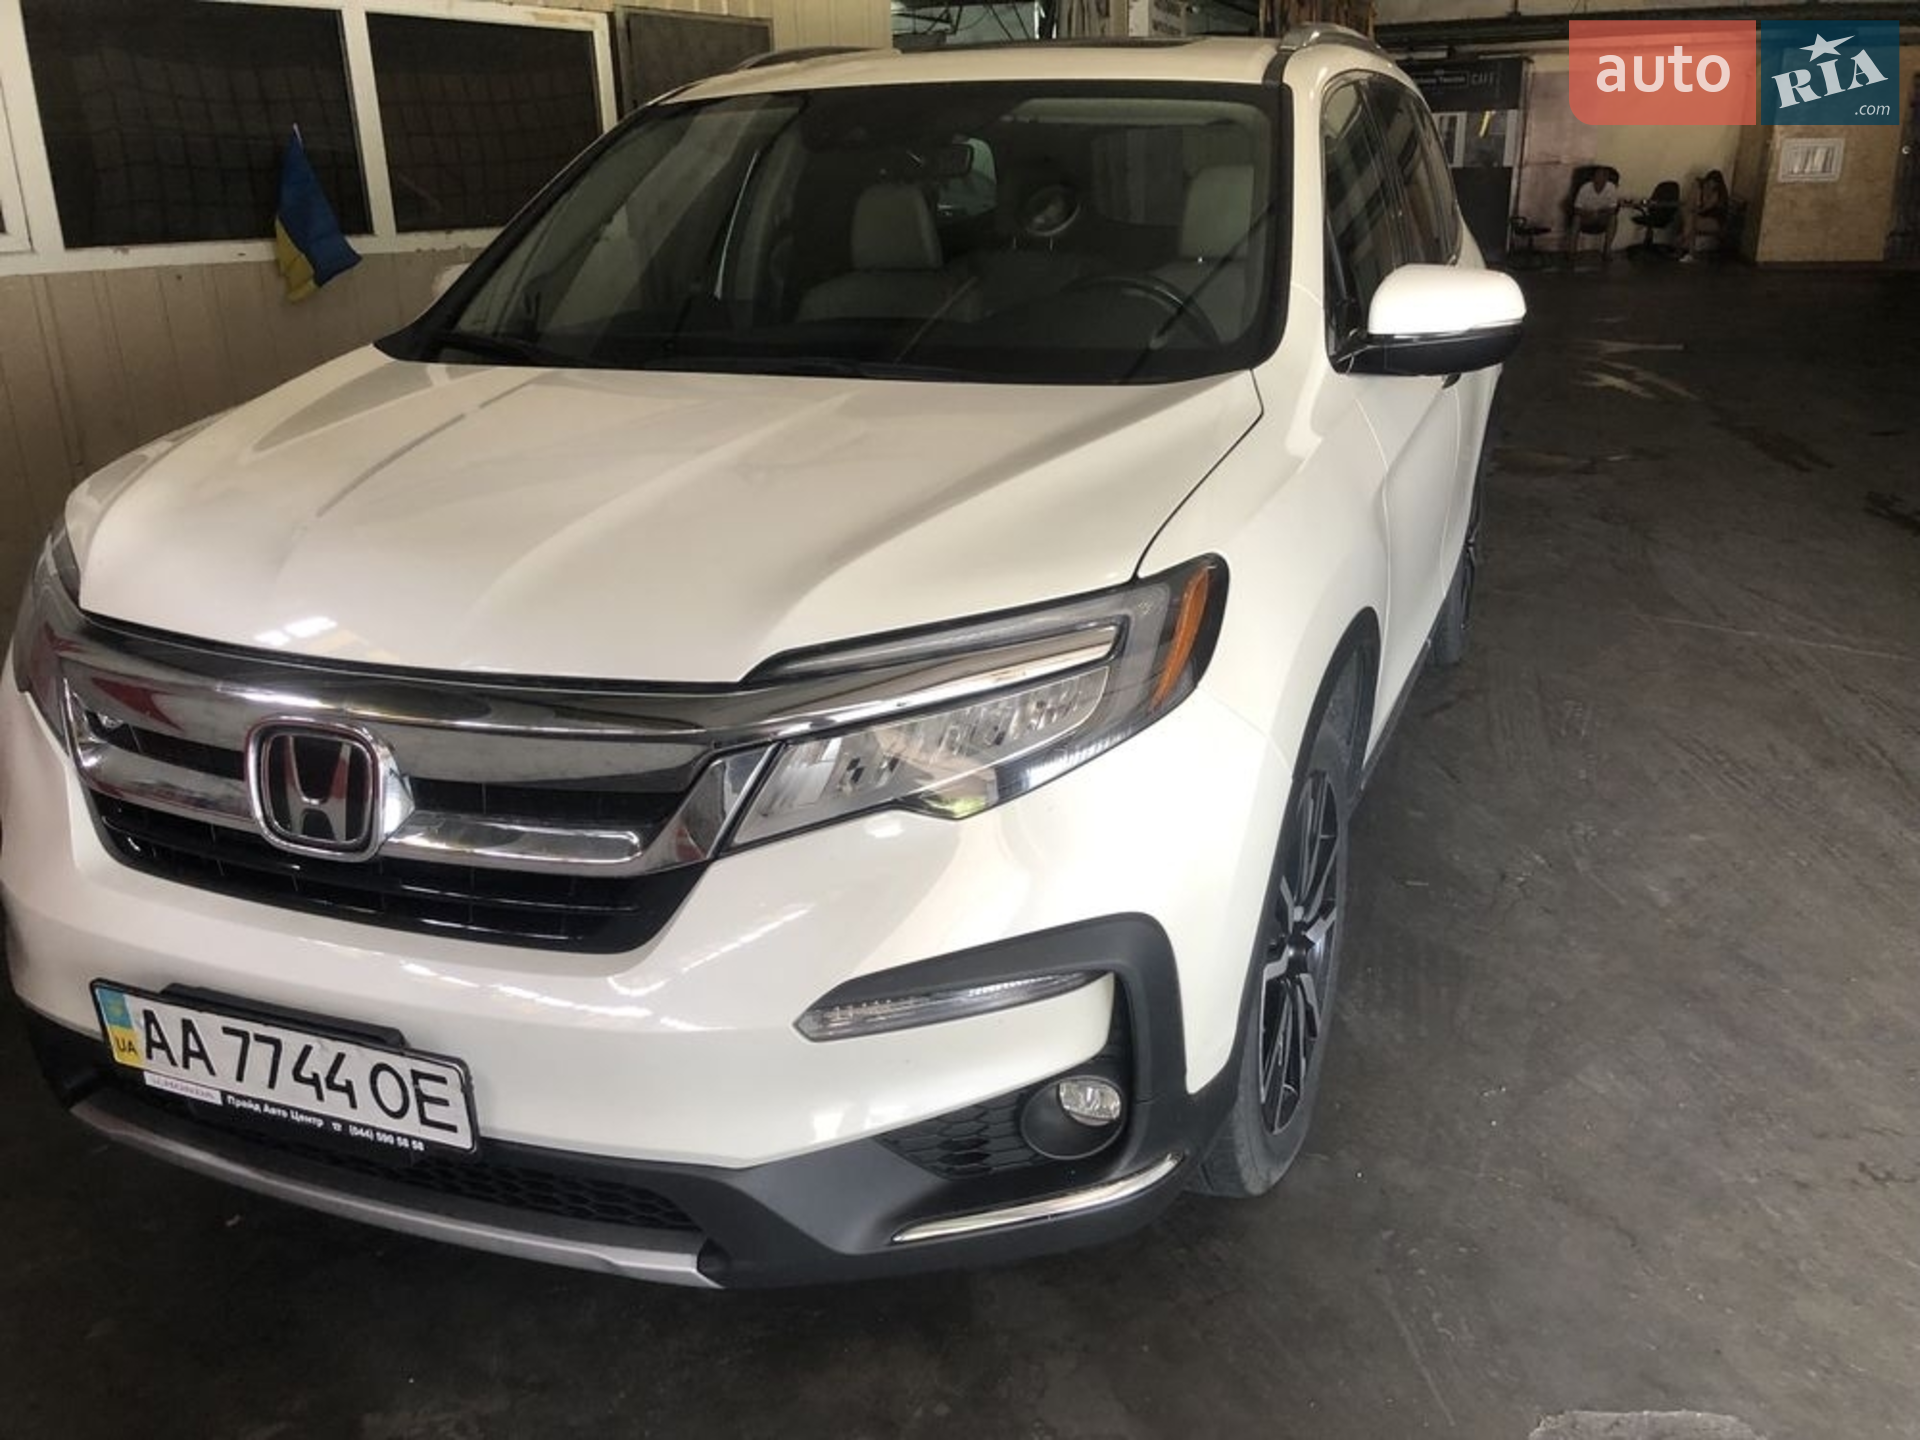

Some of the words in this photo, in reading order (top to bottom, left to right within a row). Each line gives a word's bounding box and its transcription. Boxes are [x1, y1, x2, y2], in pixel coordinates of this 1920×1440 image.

[114, 1036, 139, 1056] UA
[142, 1008, 217, 1077] AA
[221, 1025, 358, 1110] 7744
[369, 1062, 459, 1134] OE
[263, 1103, 289, 1118] Авто
[290, 1109, 324, 1128] Центр
